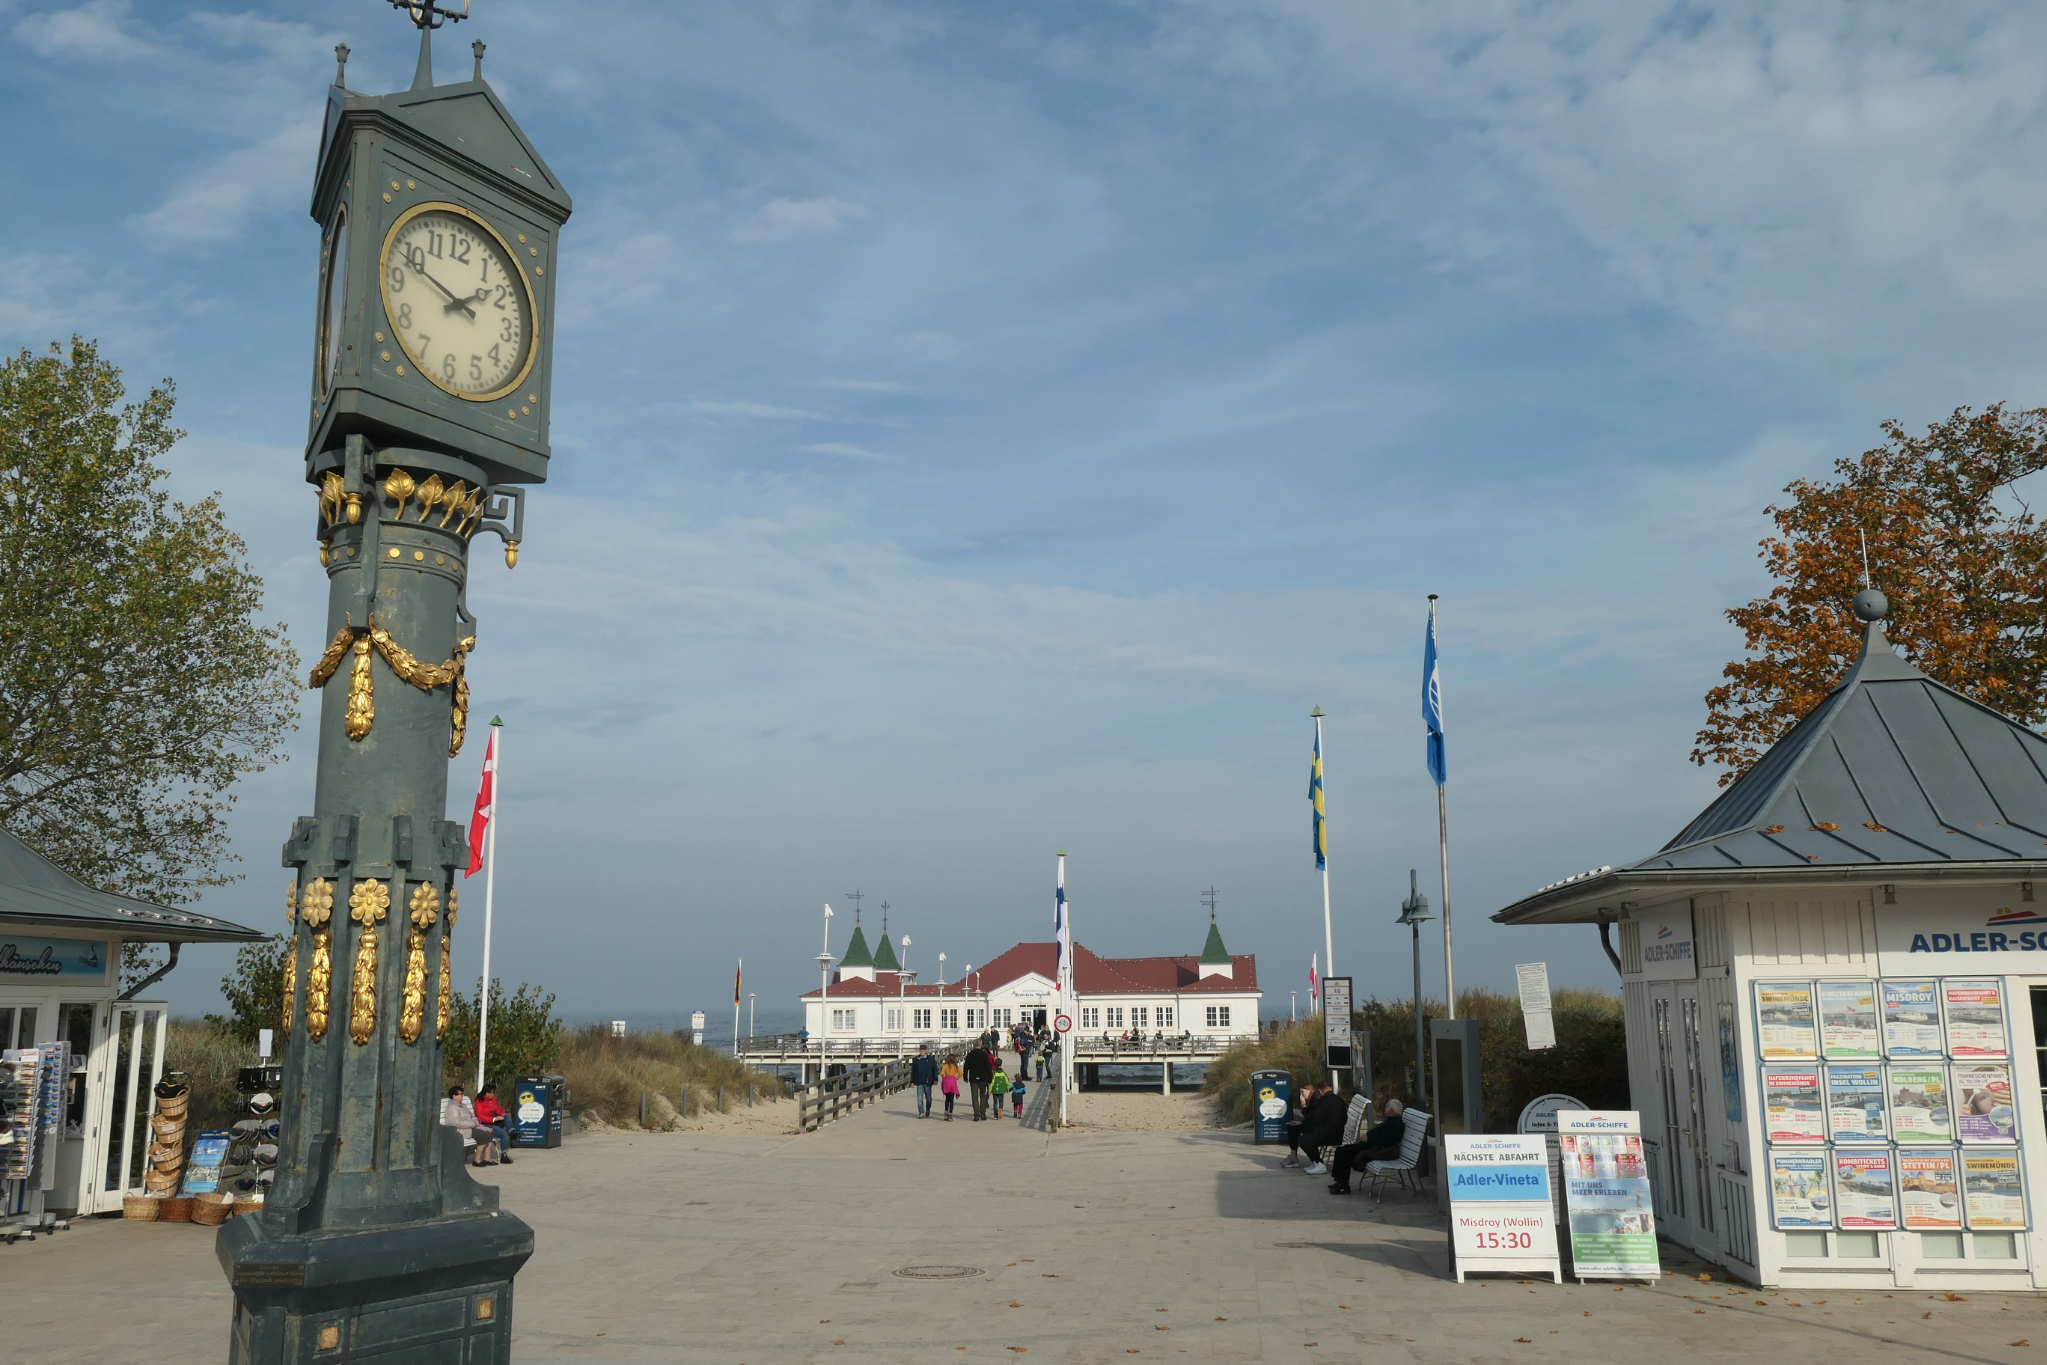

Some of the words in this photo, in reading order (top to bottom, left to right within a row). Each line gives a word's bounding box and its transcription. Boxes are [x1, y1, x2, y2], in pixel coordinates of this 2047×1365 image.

[403, 241, 426, 269] 10
[427, 229, 443, 261] 11
[449, 233, 471, 266] 12
[390, 266, 405, 293] 9
[480, 257, 489, 284] 1
[493, 284, 507, 311] 2
[397, 302, 412, 330] 8
[500, 317, 512, 343] 3
[417, 332, 431, 360] 7
[487, 342, 501, 368] 4
[443, 353, 456, 380] 6
[469, 354, 483, 381] 5
[1644, 941, 1692, 963] ADLER-SCHIFFE
[1761, 994, 1809, 1003] SWINEMÜNDE
[1886, 992, 1933, 1002] MISDROY
[1570, 1121, 1629, 1129] ADLER-SCHIFFE
[1453, 1151, 1495, 1161] NÄCHSTE
[1499, 1153, 1540, 1161] ABFAHRT
[1940, 1161, 1950, 1169] PL
[1966, 1161, 2016, 1169] SWINEMÜNDE
[1587, 1181, 1603, 1189] UNS
[1459, 1217, 1501, 1229] Misdroy
[1503, 1217, 1544, 1229] (Wollin)
[1475, 1232, 1532, 1249] 15:30
